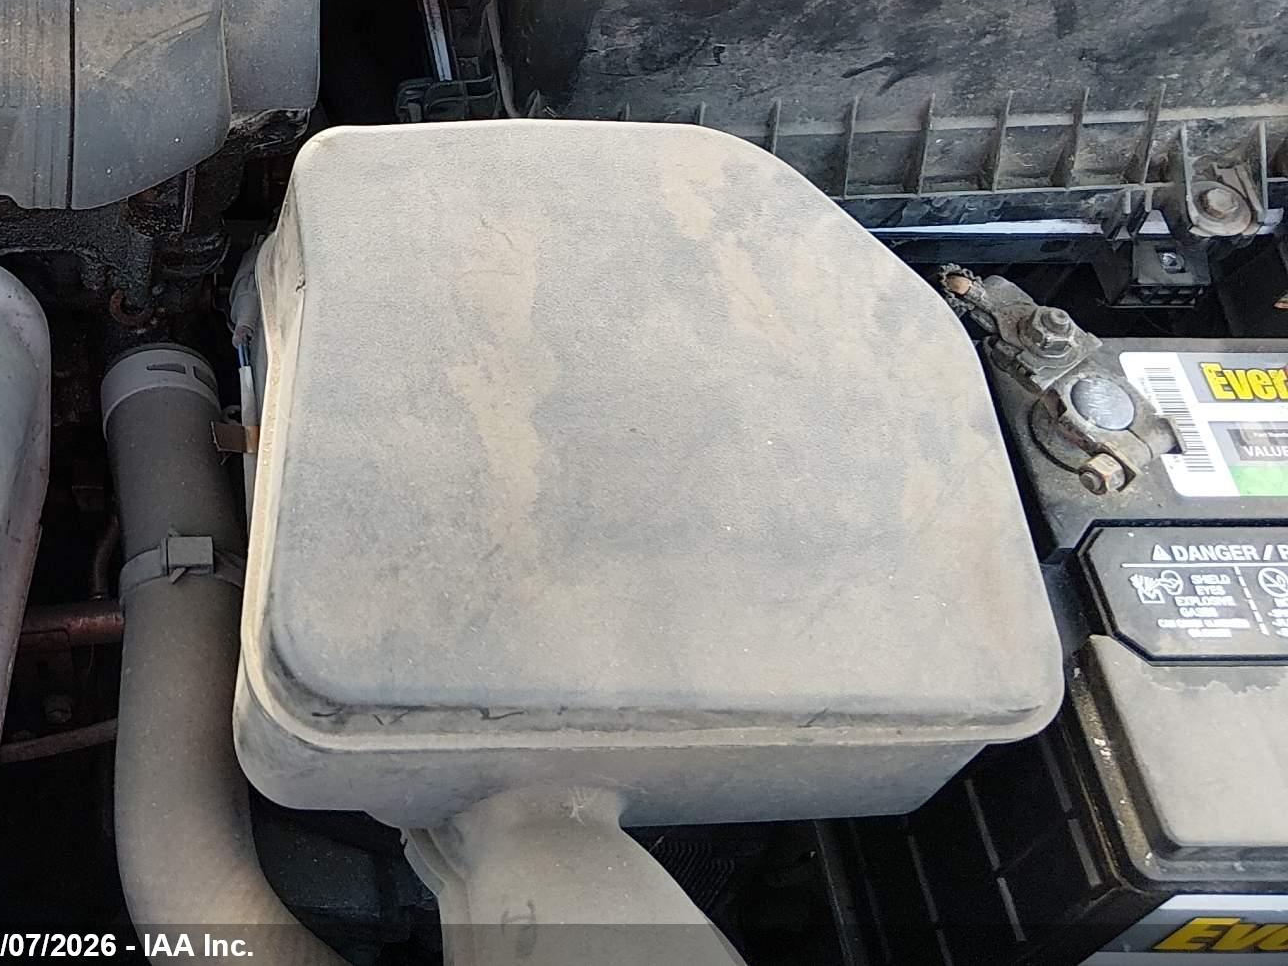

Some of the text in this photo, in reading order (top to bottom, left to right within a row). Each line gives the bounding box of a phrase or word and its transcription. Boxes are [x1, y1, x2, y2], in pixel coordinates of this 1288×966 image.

[1170, 544, 1260, 561] DANGER
[1190, 574, 1231, 584] SHIELD
[1195, 585, 1226, 595] EYES
